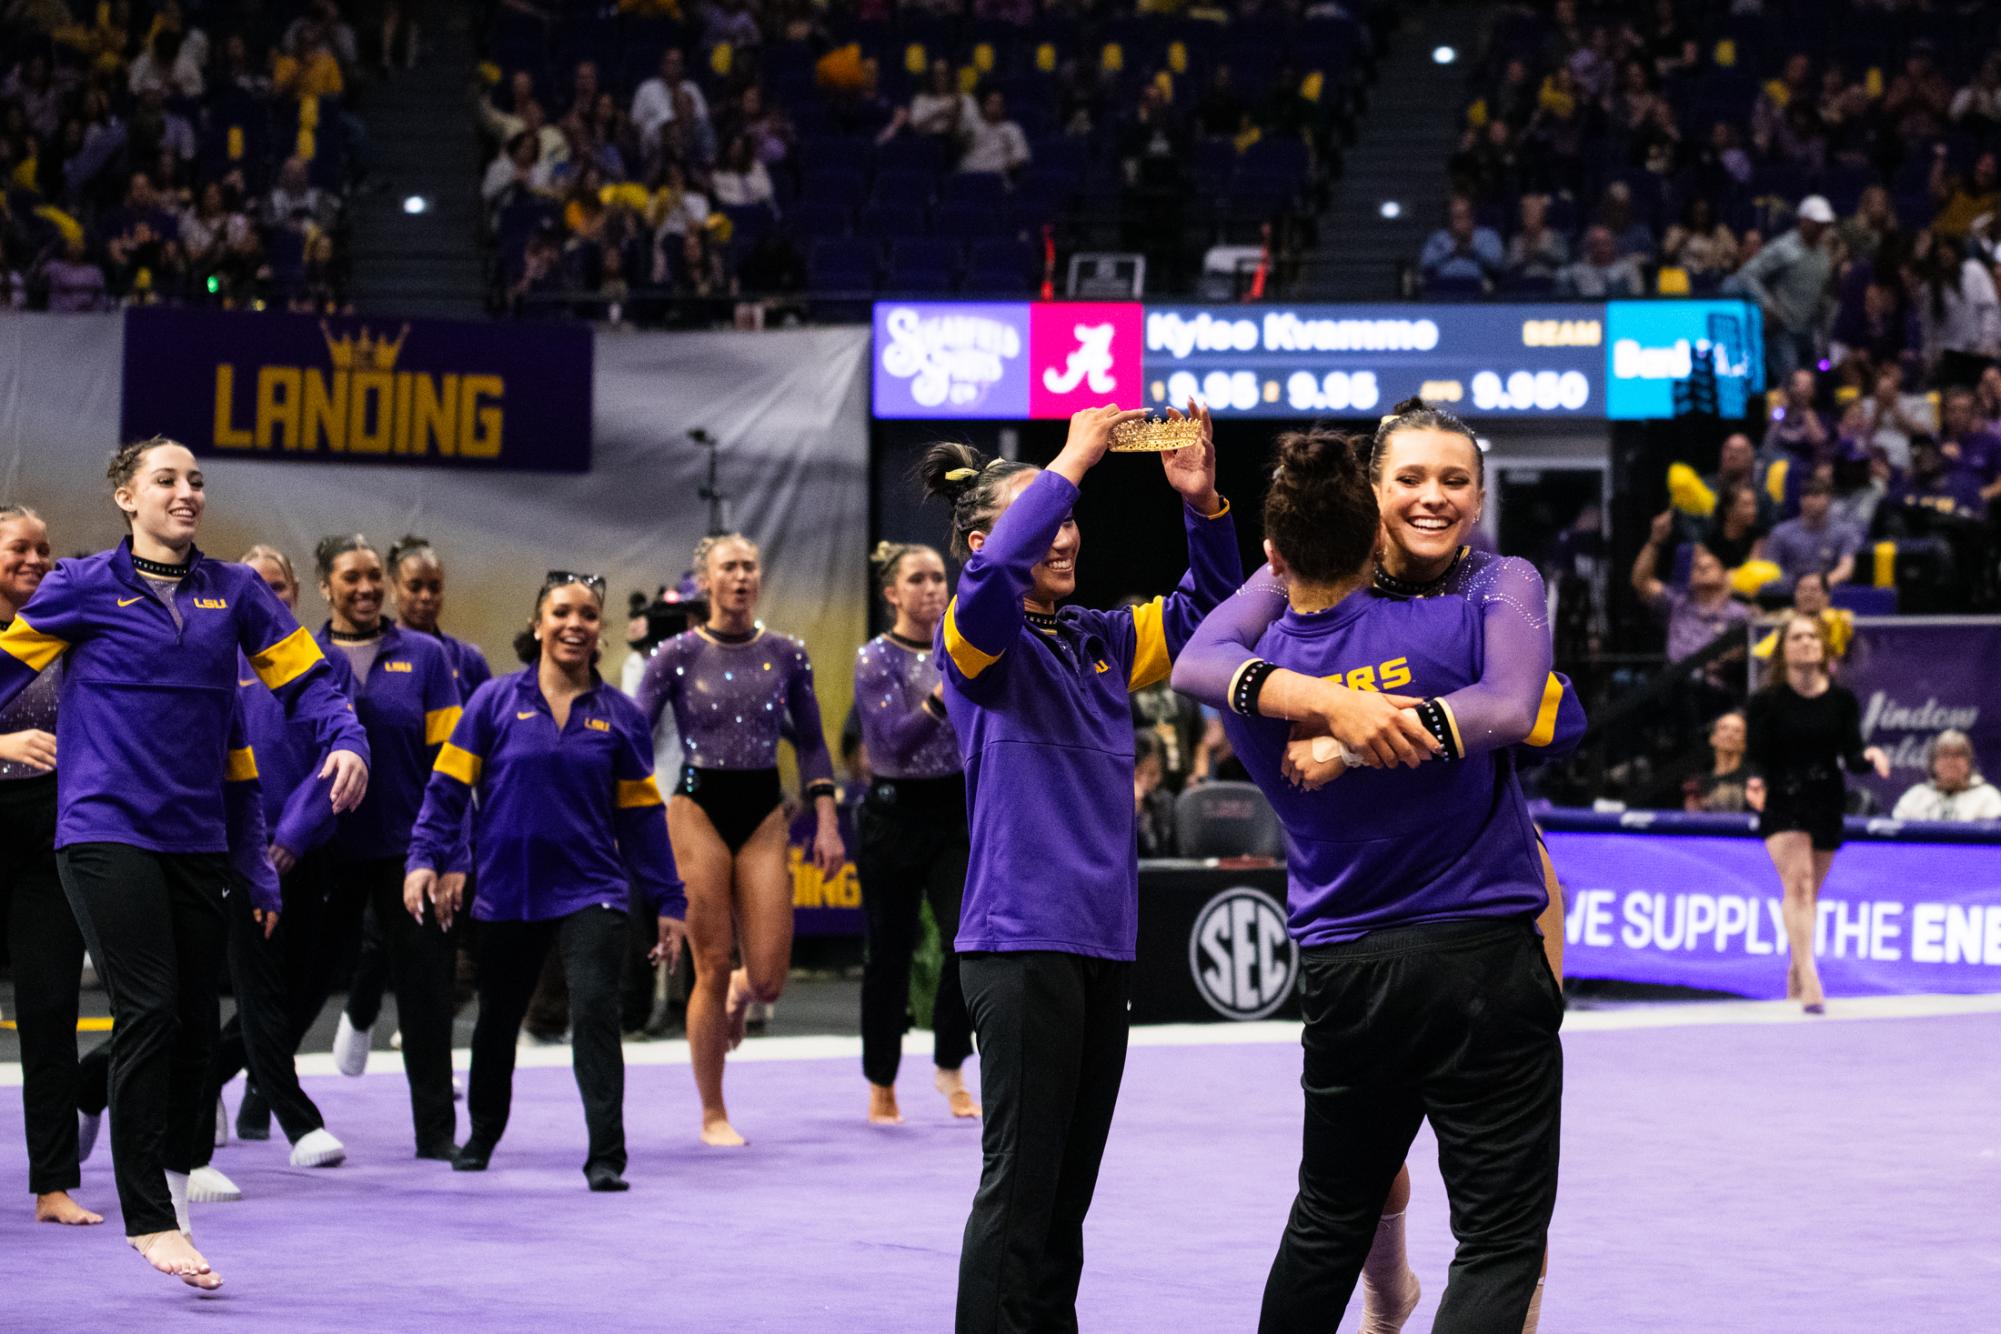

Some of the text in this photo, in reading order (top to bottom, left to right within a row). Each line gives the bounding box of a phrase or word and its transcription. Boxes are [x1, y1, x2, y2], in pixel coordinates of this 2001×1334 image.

[213, 363, 504, 458] LANDING
[193, 597, 228, 609] LSU
[1199, 898, 1288, 1010] SEC
[1620, 890, 1789, 956] SUPPLY
[1815, 899, 1904, 961] THE
